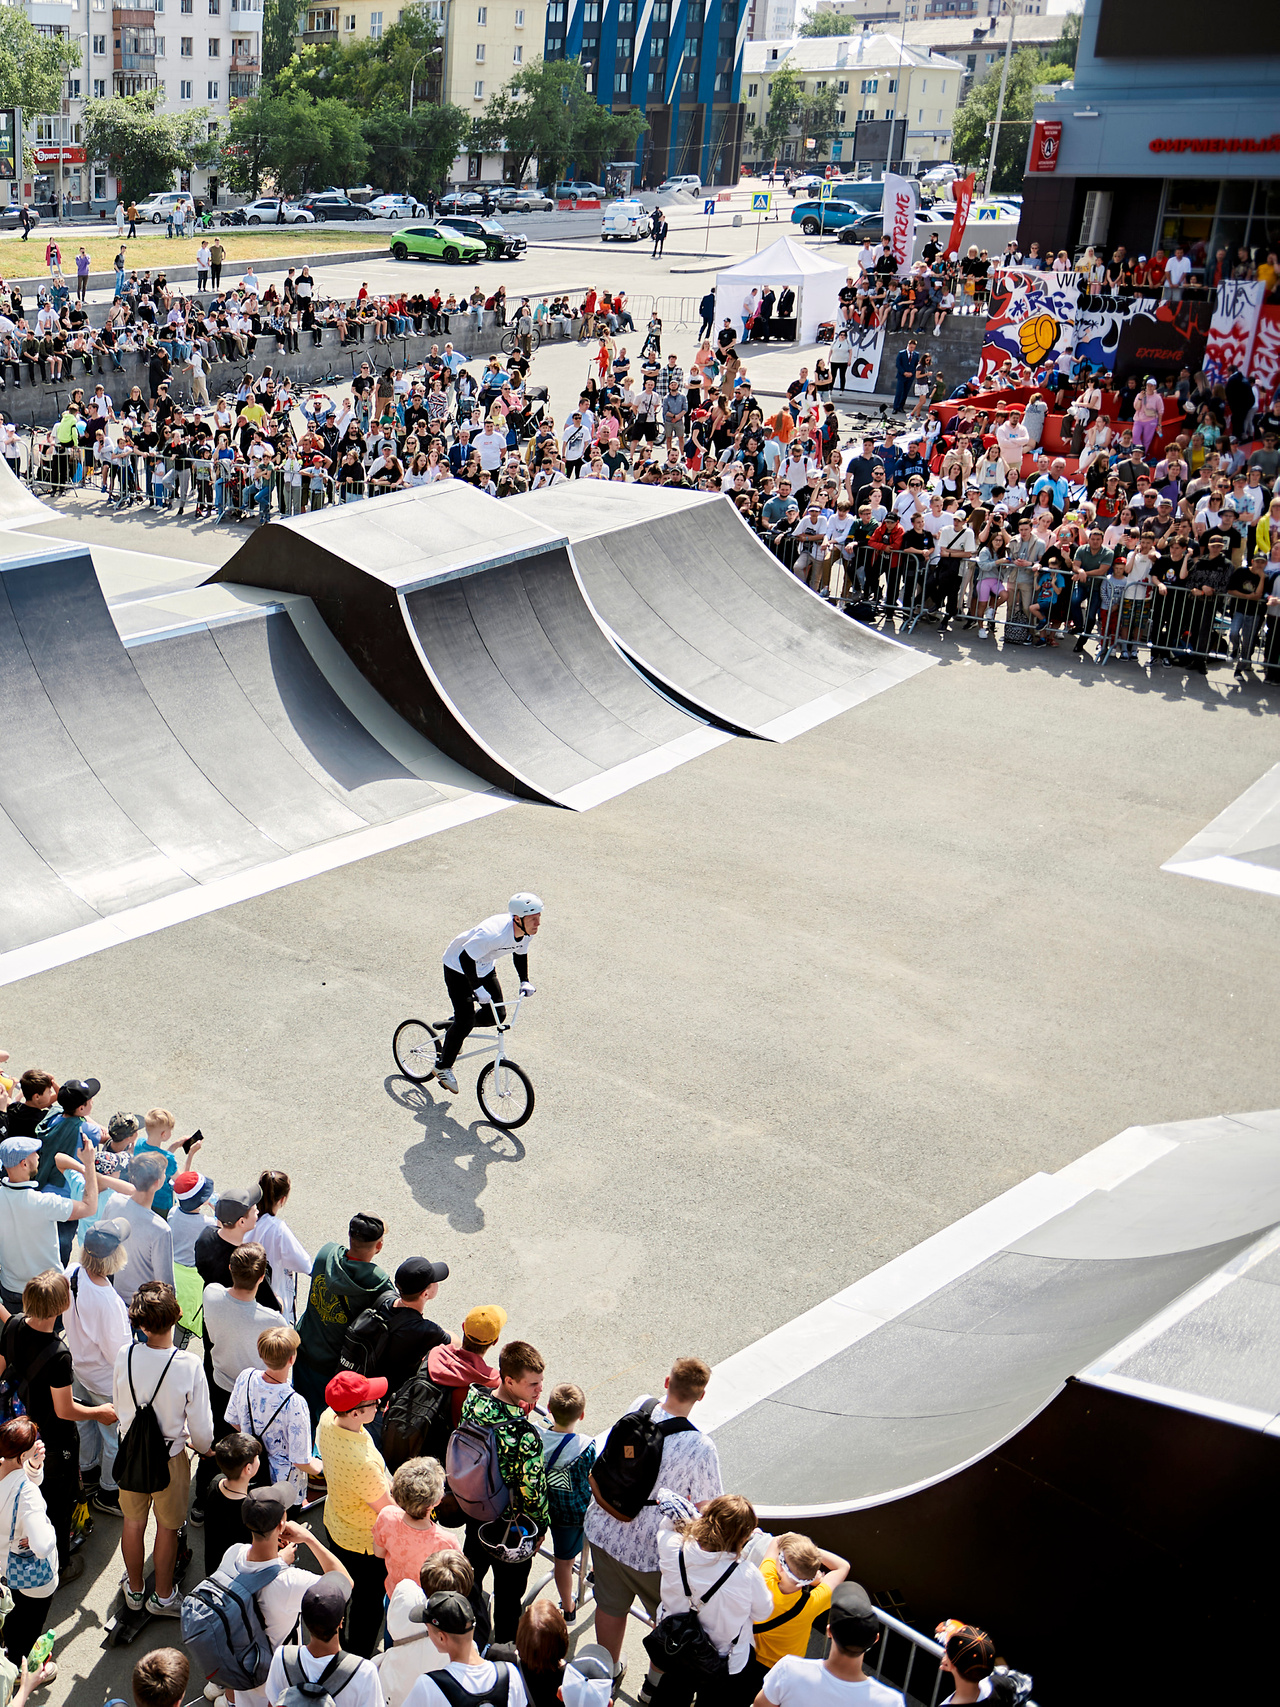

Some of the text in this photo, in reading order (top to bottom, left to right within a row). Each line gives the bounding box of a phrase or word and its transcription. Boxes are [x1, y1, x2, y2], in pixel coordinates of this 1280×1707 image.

[1148, 134, 1280, 153] ФИРМЕННЫЙ
[36, 150, 72, 161] Бристль
[893, 192, 910, 265] EXTREME
[1135, 347, 1184, 361] EXTREME
